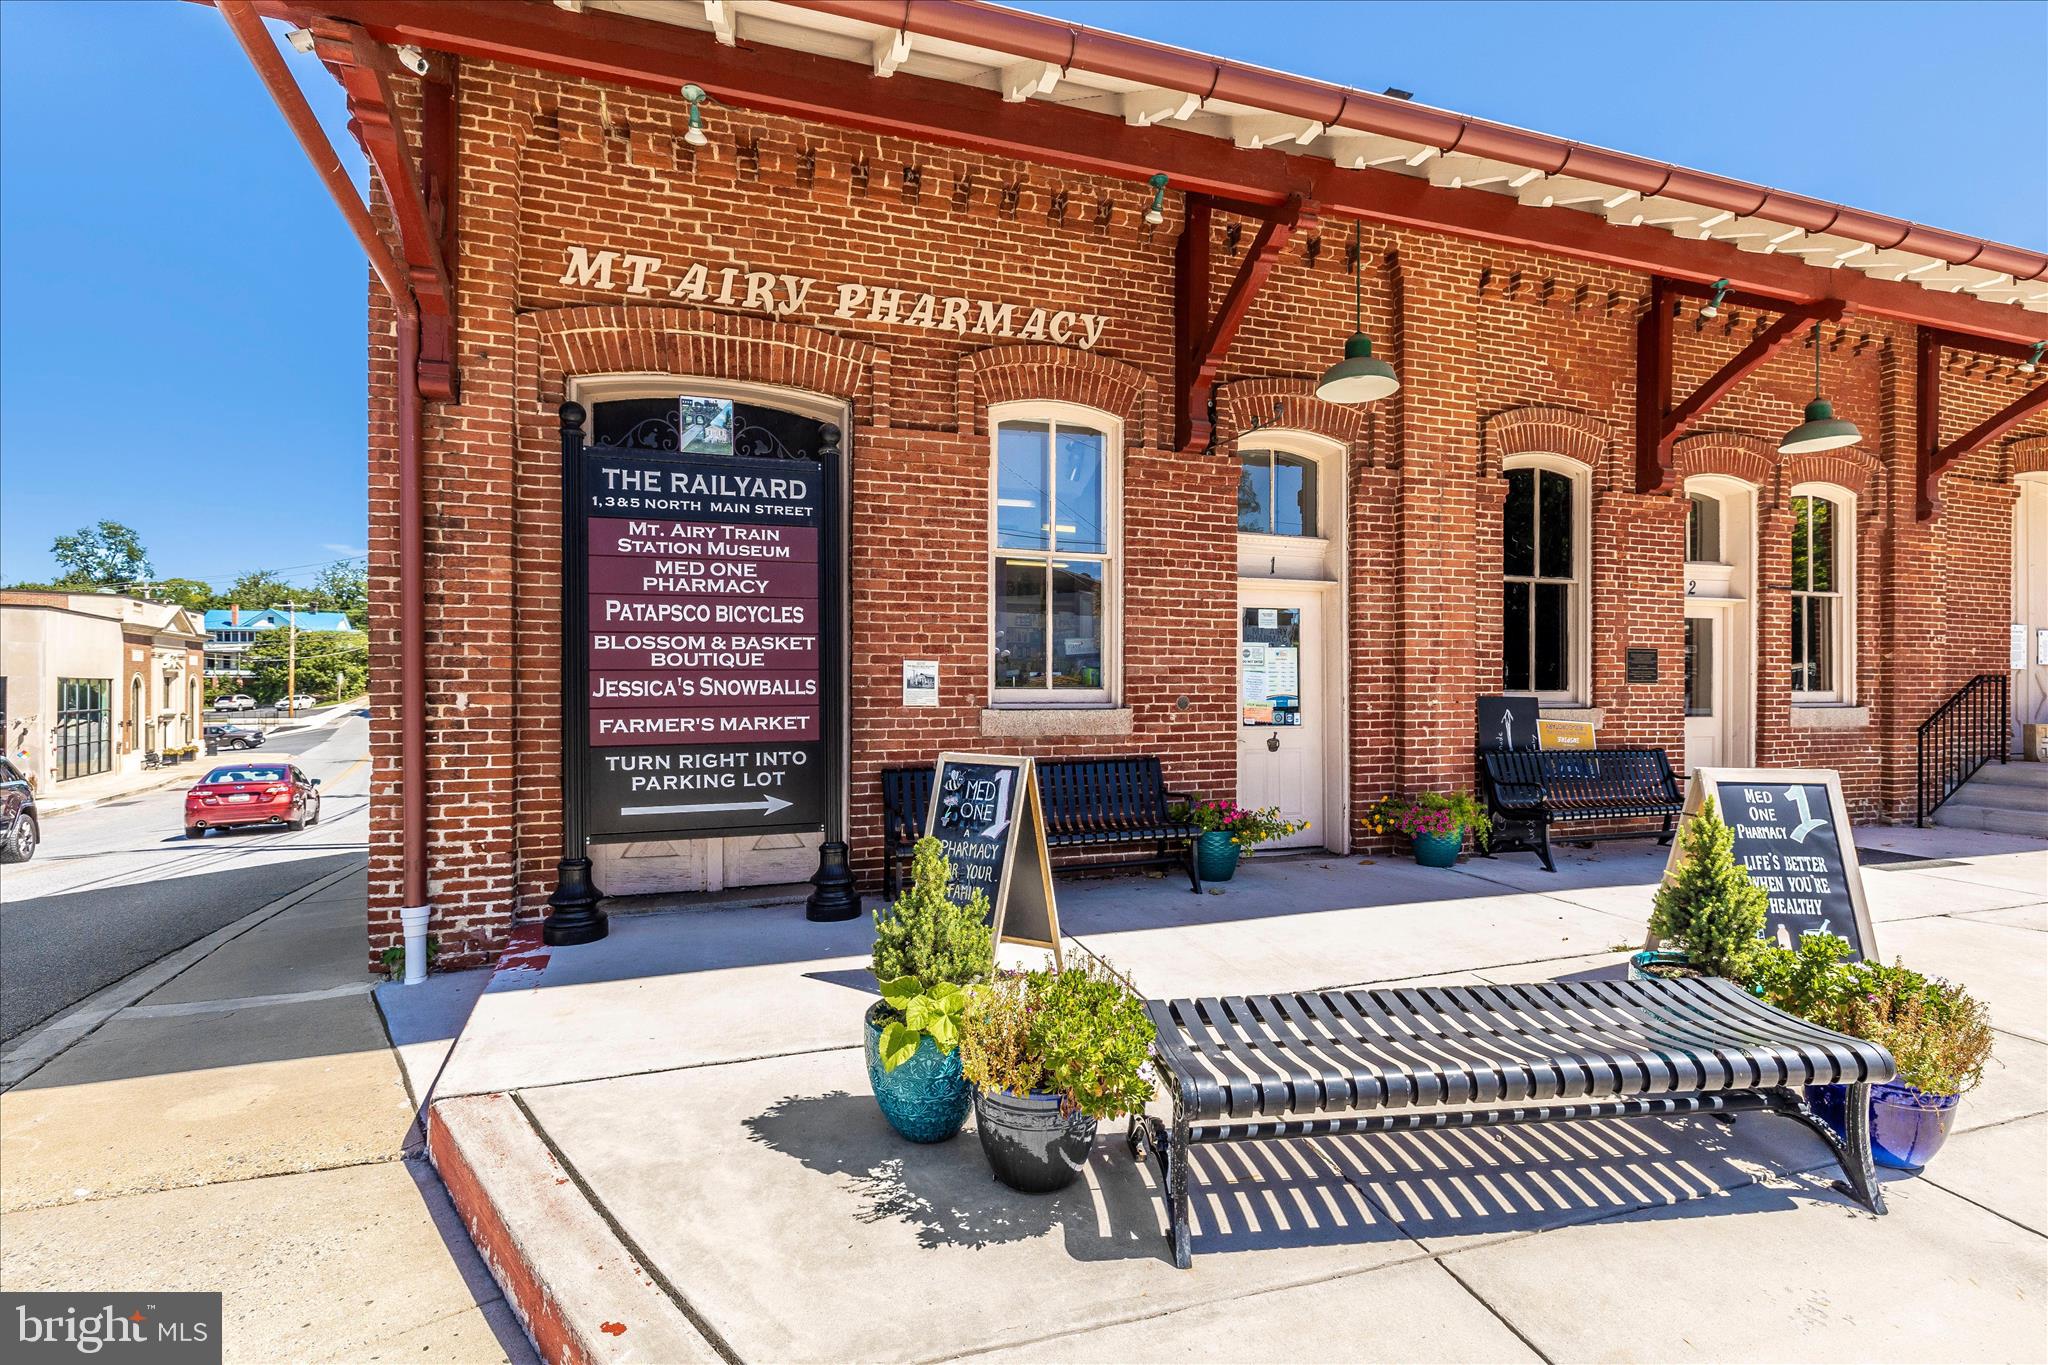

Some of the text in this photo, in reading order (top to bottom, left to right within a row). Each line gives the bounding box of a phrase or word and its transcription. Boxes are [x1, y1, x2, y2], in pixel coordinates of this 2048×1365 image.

[559, 246, 1109, 350] MT AIRY PHARMACY
[601, 467, 807, 500] THE RAILYARD
[644, 499, 701, 511] NORTH
[710, 502, 750, 514] MAIN
[755, 505, 813, 517] STREET
[655, 560, 757, 578] MED ONE
[1270, 556, 1275, 575] 1
[642, 578, 769, 594] PHARMACY
[1687, 580, 1696, 595] 2
[715, 604, 805, 624] BICYCLES
[594, 635, 816, 650] BLOSSOM & BASKET
[650, 652, 765, 668] BOUTIQUE
[599, 715, 810, 734] FARMER'S MARKET
[605, 750, 807, 771] TURN RIGHT INTO
[631, 771, 786, 791] PARKING LOT
[965, 780, 997, 802] MED
[960, 802, 995, 822] ONE
[963, 829, 970, 838] A
[941, 839, 1000, 860] PHARMACY
[1744, 853, 1828, 873] LIFE'S BETTER
[1746, 875, 1831, 894] WHEN YOU'RE
[1770, 899, 1822, 915] HEALTHY
